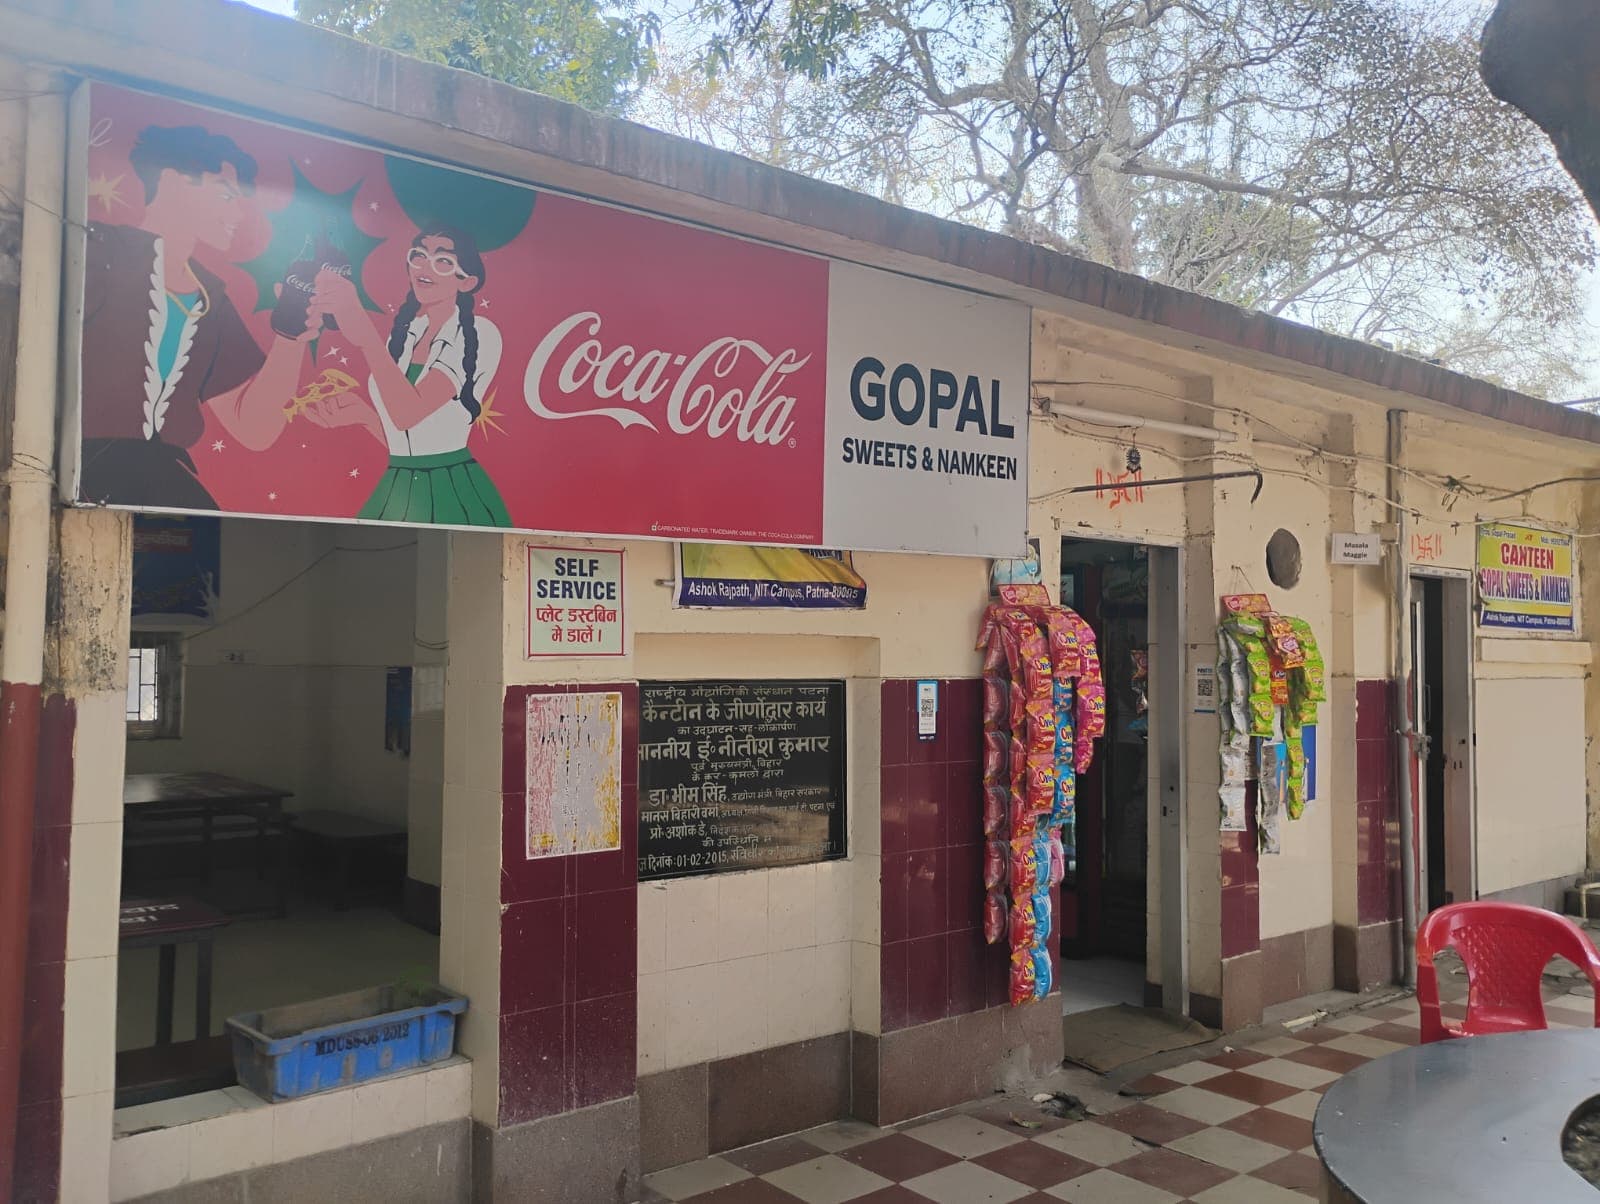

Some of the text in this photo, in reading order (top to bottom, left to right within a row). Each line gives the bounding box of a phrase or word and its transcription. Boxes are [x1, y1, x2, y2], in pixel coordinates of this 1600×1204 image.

[523, 311, 812, 447] Coca-Cola
[850, 356, 1015, 439] GOPAL
[842, 437, 1018, 481] SWEETS & NAMKEEN
[1501, 543, 1554, 570] CANTEEN
[555, 557, 599, 577] SELF
[537, 579, 616, 600] SERVICE
[688, 581, 717, 596] Ashok
[719, 583, 752, 601] Rajpath,
[754, 584, 769, 598] NIT
[1481, 568, 1571, 603] GOPAL SWEETS & NAMKEEN
[536, 604, 617, 623] प्लेट डस्टबिन
[644, 686, 686, 700] राष्ट्रीय
[753, 686, 794, 696] संस्थान
[799, 687, 829, 696] पटना
[705, 699, 721, 721] के
[795, 696, 827, 717] कार्य
[677, 725, 690, 735] का
[718, 735, 774, 757] नीतीश
[778, 736, 831, 759] कुमार
[691, 761, 705, 771] पूर्व
[757, 758, 782, 769] बिहार
[692, 772, 701, 782] के
[671, 783, 699, 804] भीम
[775, 787, 795, 800] बिहार
[796, 787, 822, 797] सरकार
[641, 809, 669, 823] मानस
[671, 806, 700, 822] बिहारी
[808, 803, 825, 812] पटना
[665, 823, 698, 839] अशोक
[702, 836, 714, 848] की
